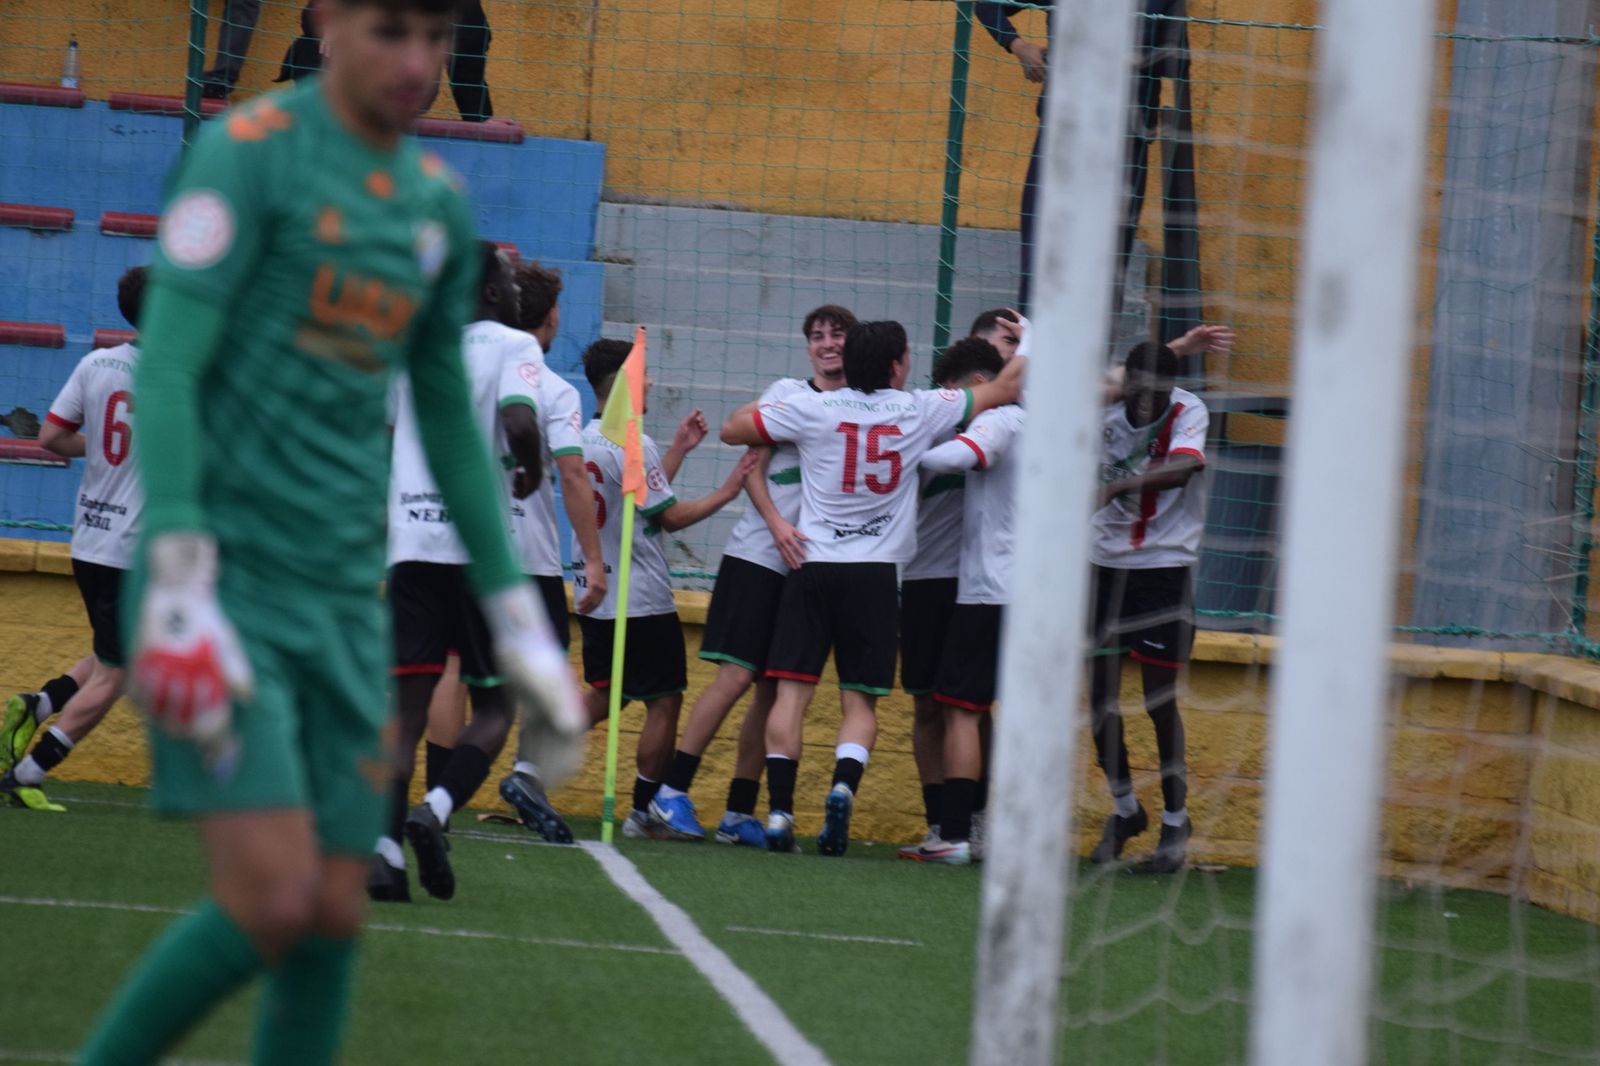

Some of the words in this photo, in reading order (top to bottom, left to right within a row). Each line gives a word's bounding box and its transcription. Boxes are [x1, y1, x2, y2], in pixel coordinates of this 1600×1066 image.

[91, 358, 135, 373] SPORTIN
[103, 390, 135, 466] 6
[836, 421, 903, 495] 15
